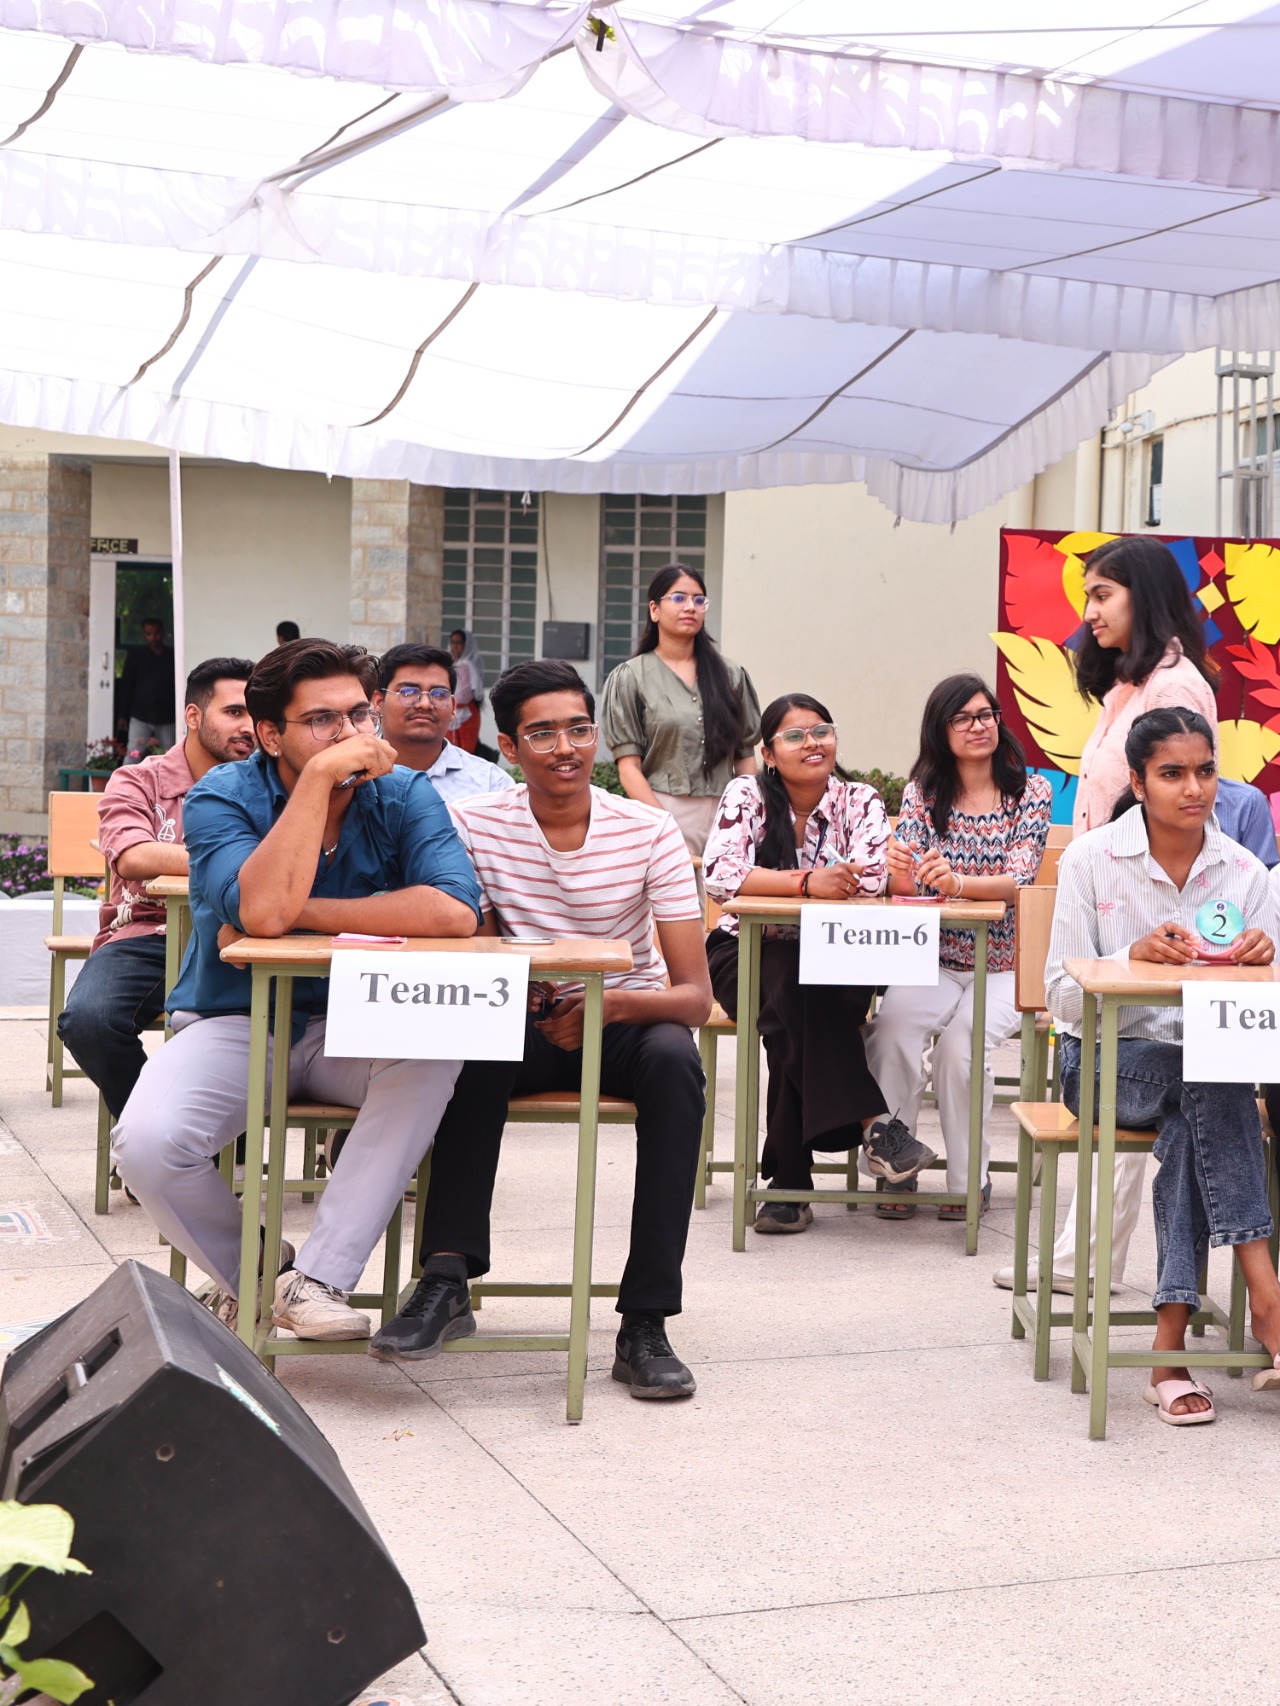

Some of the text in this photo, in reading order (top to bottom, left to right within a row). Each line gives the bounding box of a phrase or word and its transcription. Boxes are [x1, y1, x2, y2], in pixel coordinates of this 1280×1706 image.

[90, 539, 129, 552] FFICE
[822, 921, 928, 947] Team-6
[1211, 914, 1227, 938] 2
[360, 972, 510, 1007] Team-3
